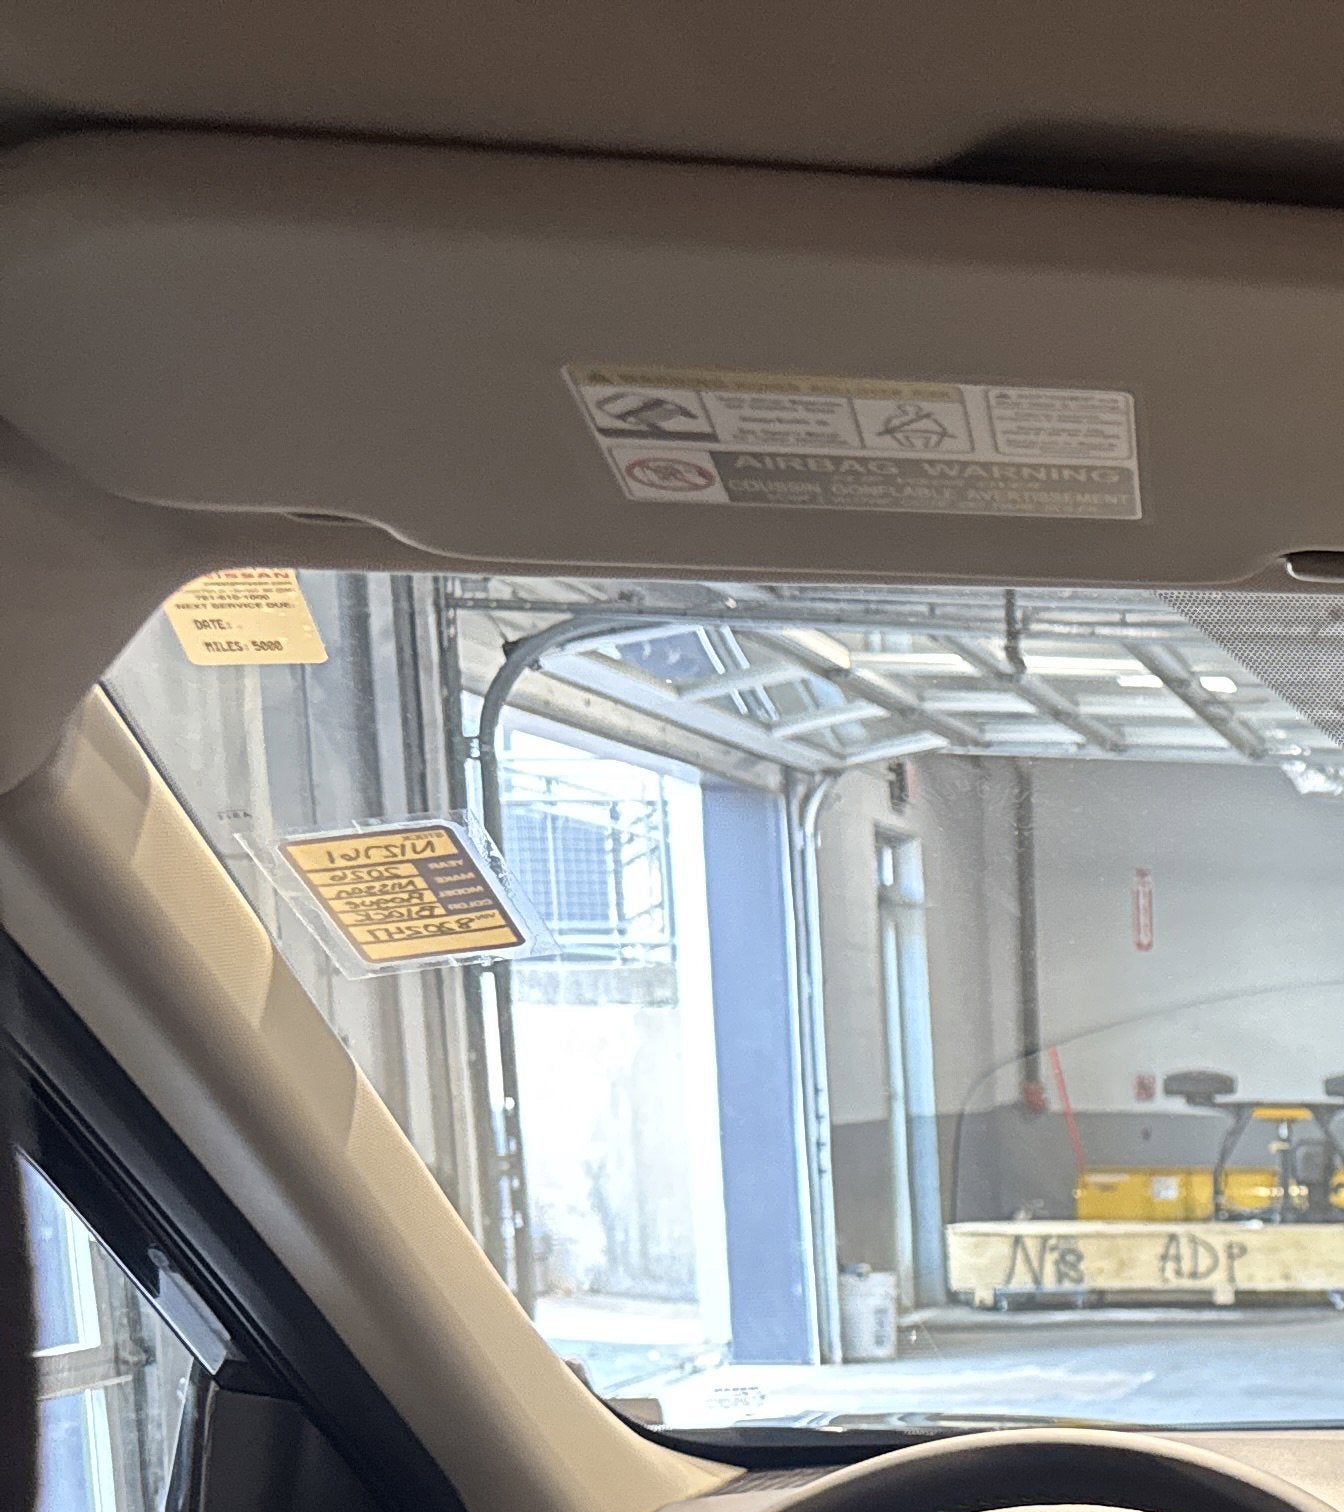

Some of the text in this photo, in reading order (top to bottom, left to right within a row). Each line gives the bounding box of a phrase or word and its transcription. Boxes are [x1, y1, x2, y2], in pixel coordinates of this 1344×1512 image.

[735, 455, 898, 474] AIRBAG
[922, 461, 1119, 483] WARNING
[251, 640, 284, 652] 5000
[1160, 1233, 1248, 1283] ADP
